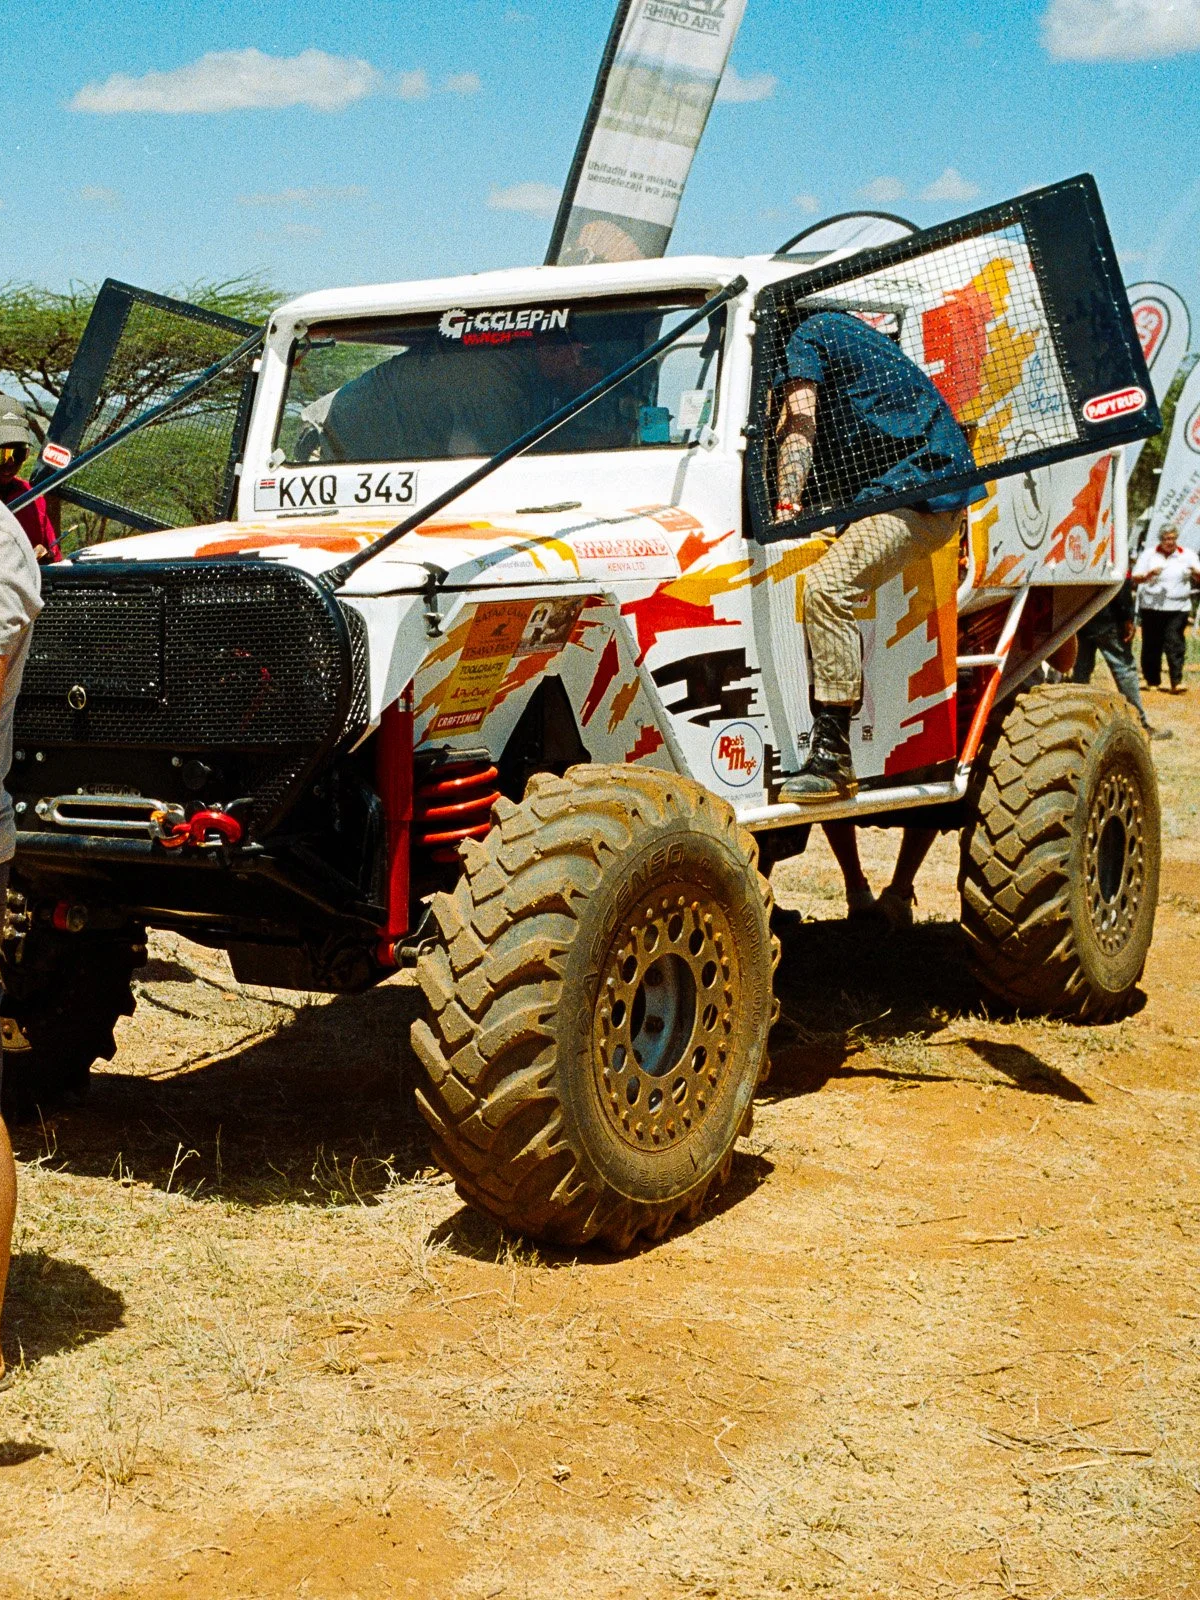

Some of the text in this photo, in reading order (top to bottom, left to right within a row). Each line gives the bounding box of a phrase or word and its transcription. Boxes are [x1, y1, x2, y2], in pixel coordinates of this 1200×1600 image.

[643, 3, 722, 32] RHINO ARK
[1087, 391, 1143, 418] PAPYRUS
[279, 472, 414, 507] KXQ 343
[607, 562, 631, 572] KENYA
[437, 711, 483, 727] CRAFTSMAN
